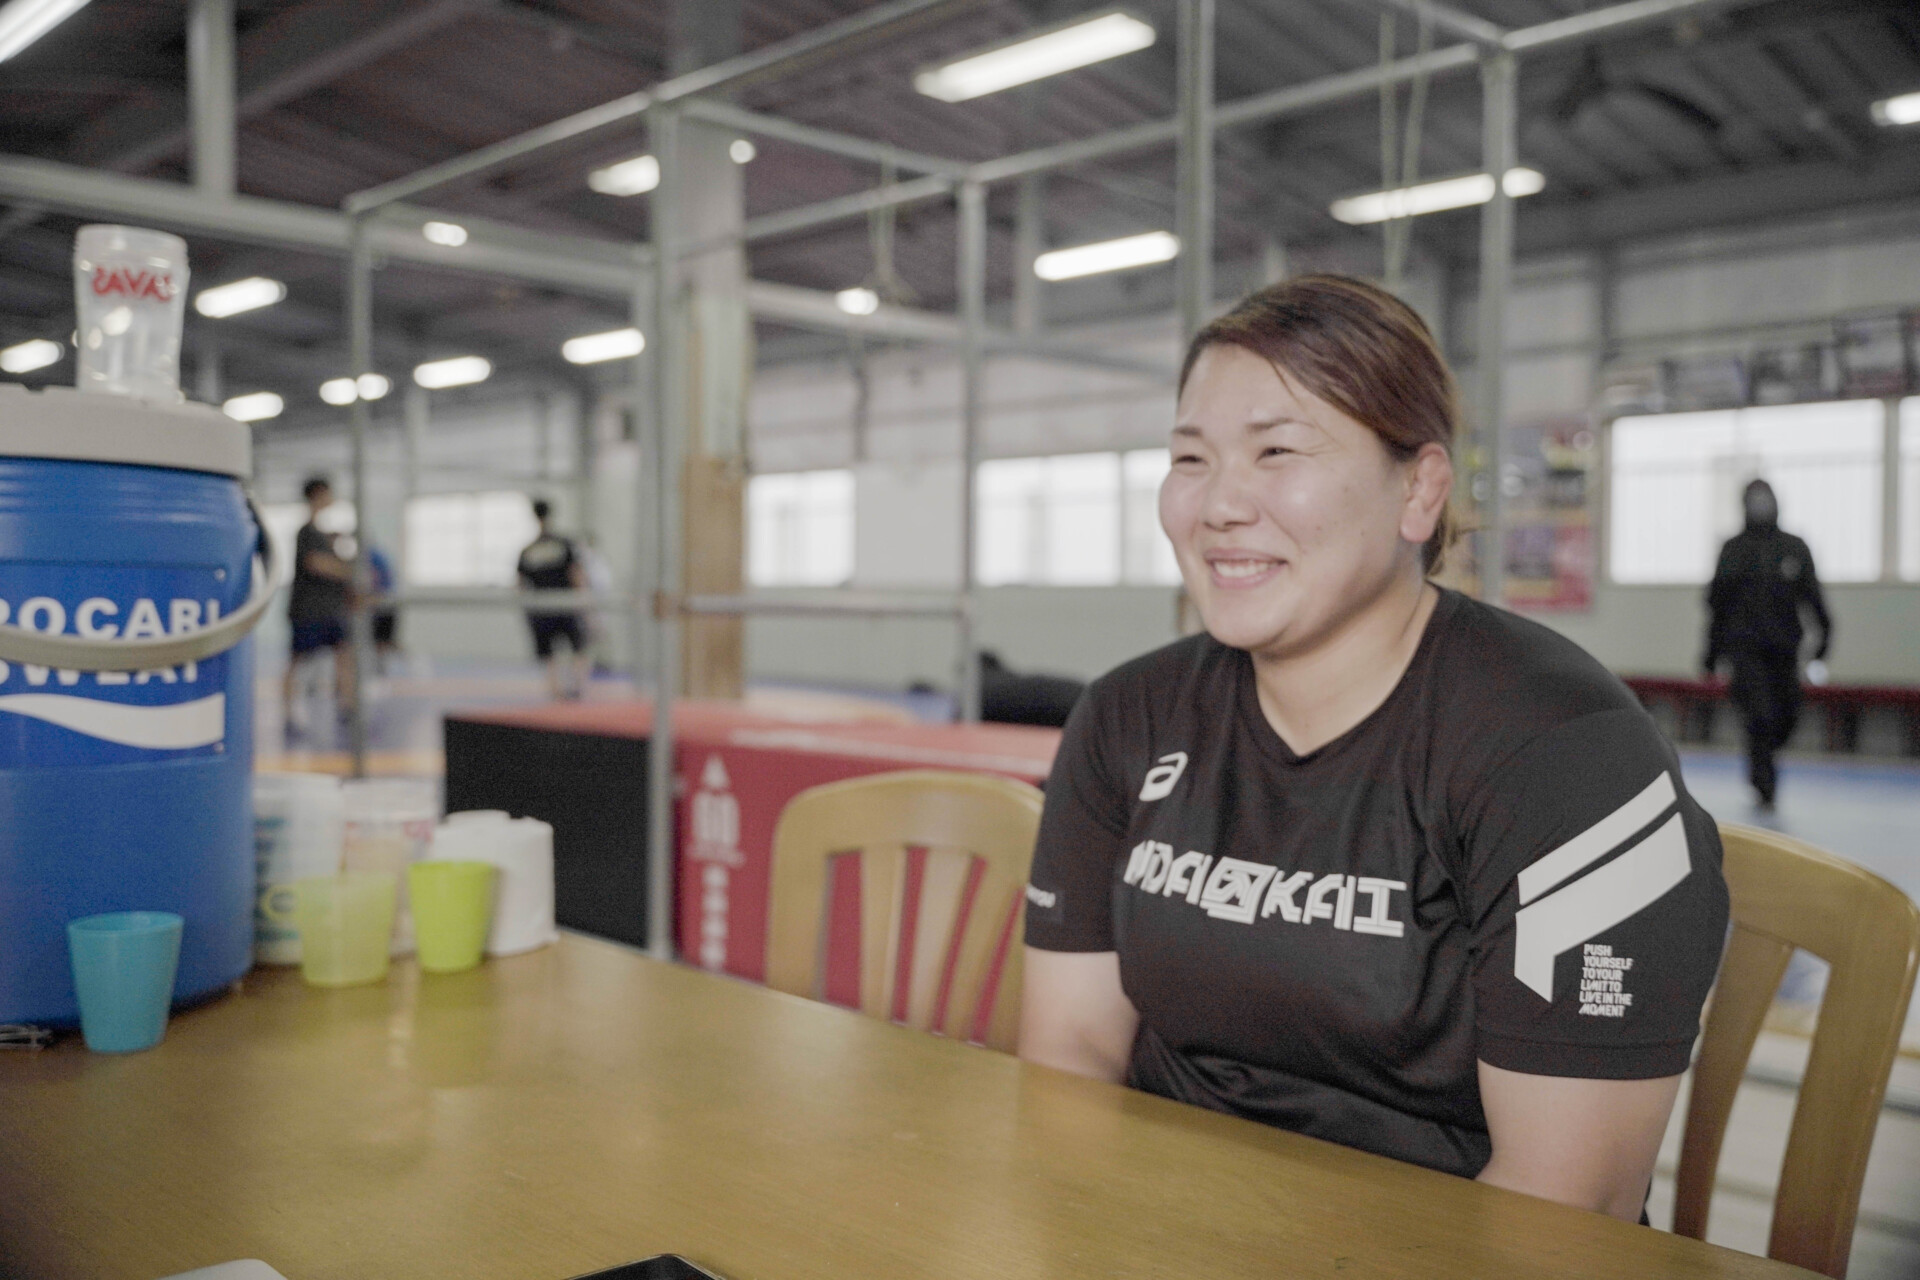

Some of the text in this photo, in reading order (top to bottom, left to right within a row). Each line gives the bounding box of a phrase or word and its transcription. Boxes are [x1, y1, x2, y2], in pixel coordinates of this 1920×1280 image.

[0, 596, 220, 640] OCARI
[1583, 944, 1612, 956] PUSH
[1583, 956, 1633, 970] YOURSELF
[1582, 967, 1624, 982] TO YOUR
[1580, 979, 1623, 993] LIMIT TO
[1579, 990, 1633, 1006] LIVE IN THE
[1579, 1003, 1625, 1017] MOMENT
